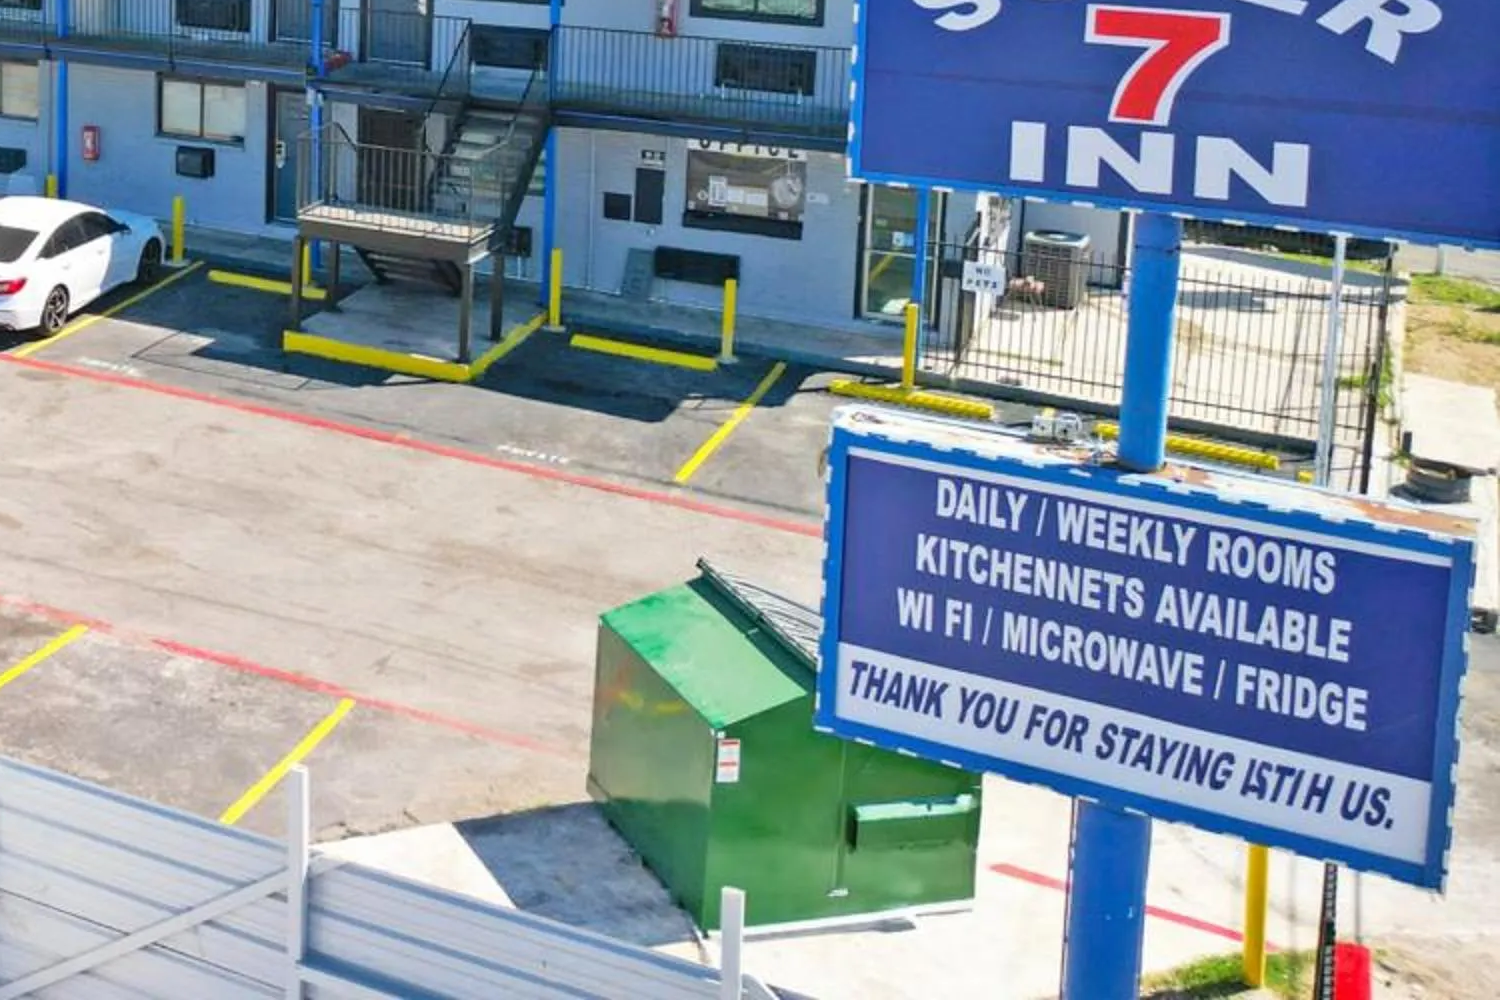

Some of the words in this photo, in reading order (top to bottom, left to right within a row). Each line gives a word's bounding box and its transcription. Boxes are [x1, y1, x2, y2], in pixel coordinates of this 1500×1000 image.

[1084, 4, 1231, 126] 7
[1010, 121, 1310, 207] INN
[916, 534, 1145, 619] KITCHENNETS
[1155, 585, 1352, 663] AVAILABLE
[937, 479, 1028, 533] DAILY
[1035, 498, 1049, 537] /
[1057, 502, 1197, 566] WEEKLY
[1207, 533, 1336, 595] ROOMS
[898, 587, 933, 632] WI
[944, 602, 972, 642] FI
[982, 608, 994, 645] /
[1002, 612, 1203, 697] MICROWAVE
[1213, 659, 1226, 700] /
[1235, 664, 1368, 731] FRIDGE
[849, 660, 949, 719] THANK
[958, 687, 1018, 735] YOU
[1024, 704, 1090, 753] FOR
[1094, 723, 1235, 792] STAYING
[1340, 780, 1394, 830] US.
